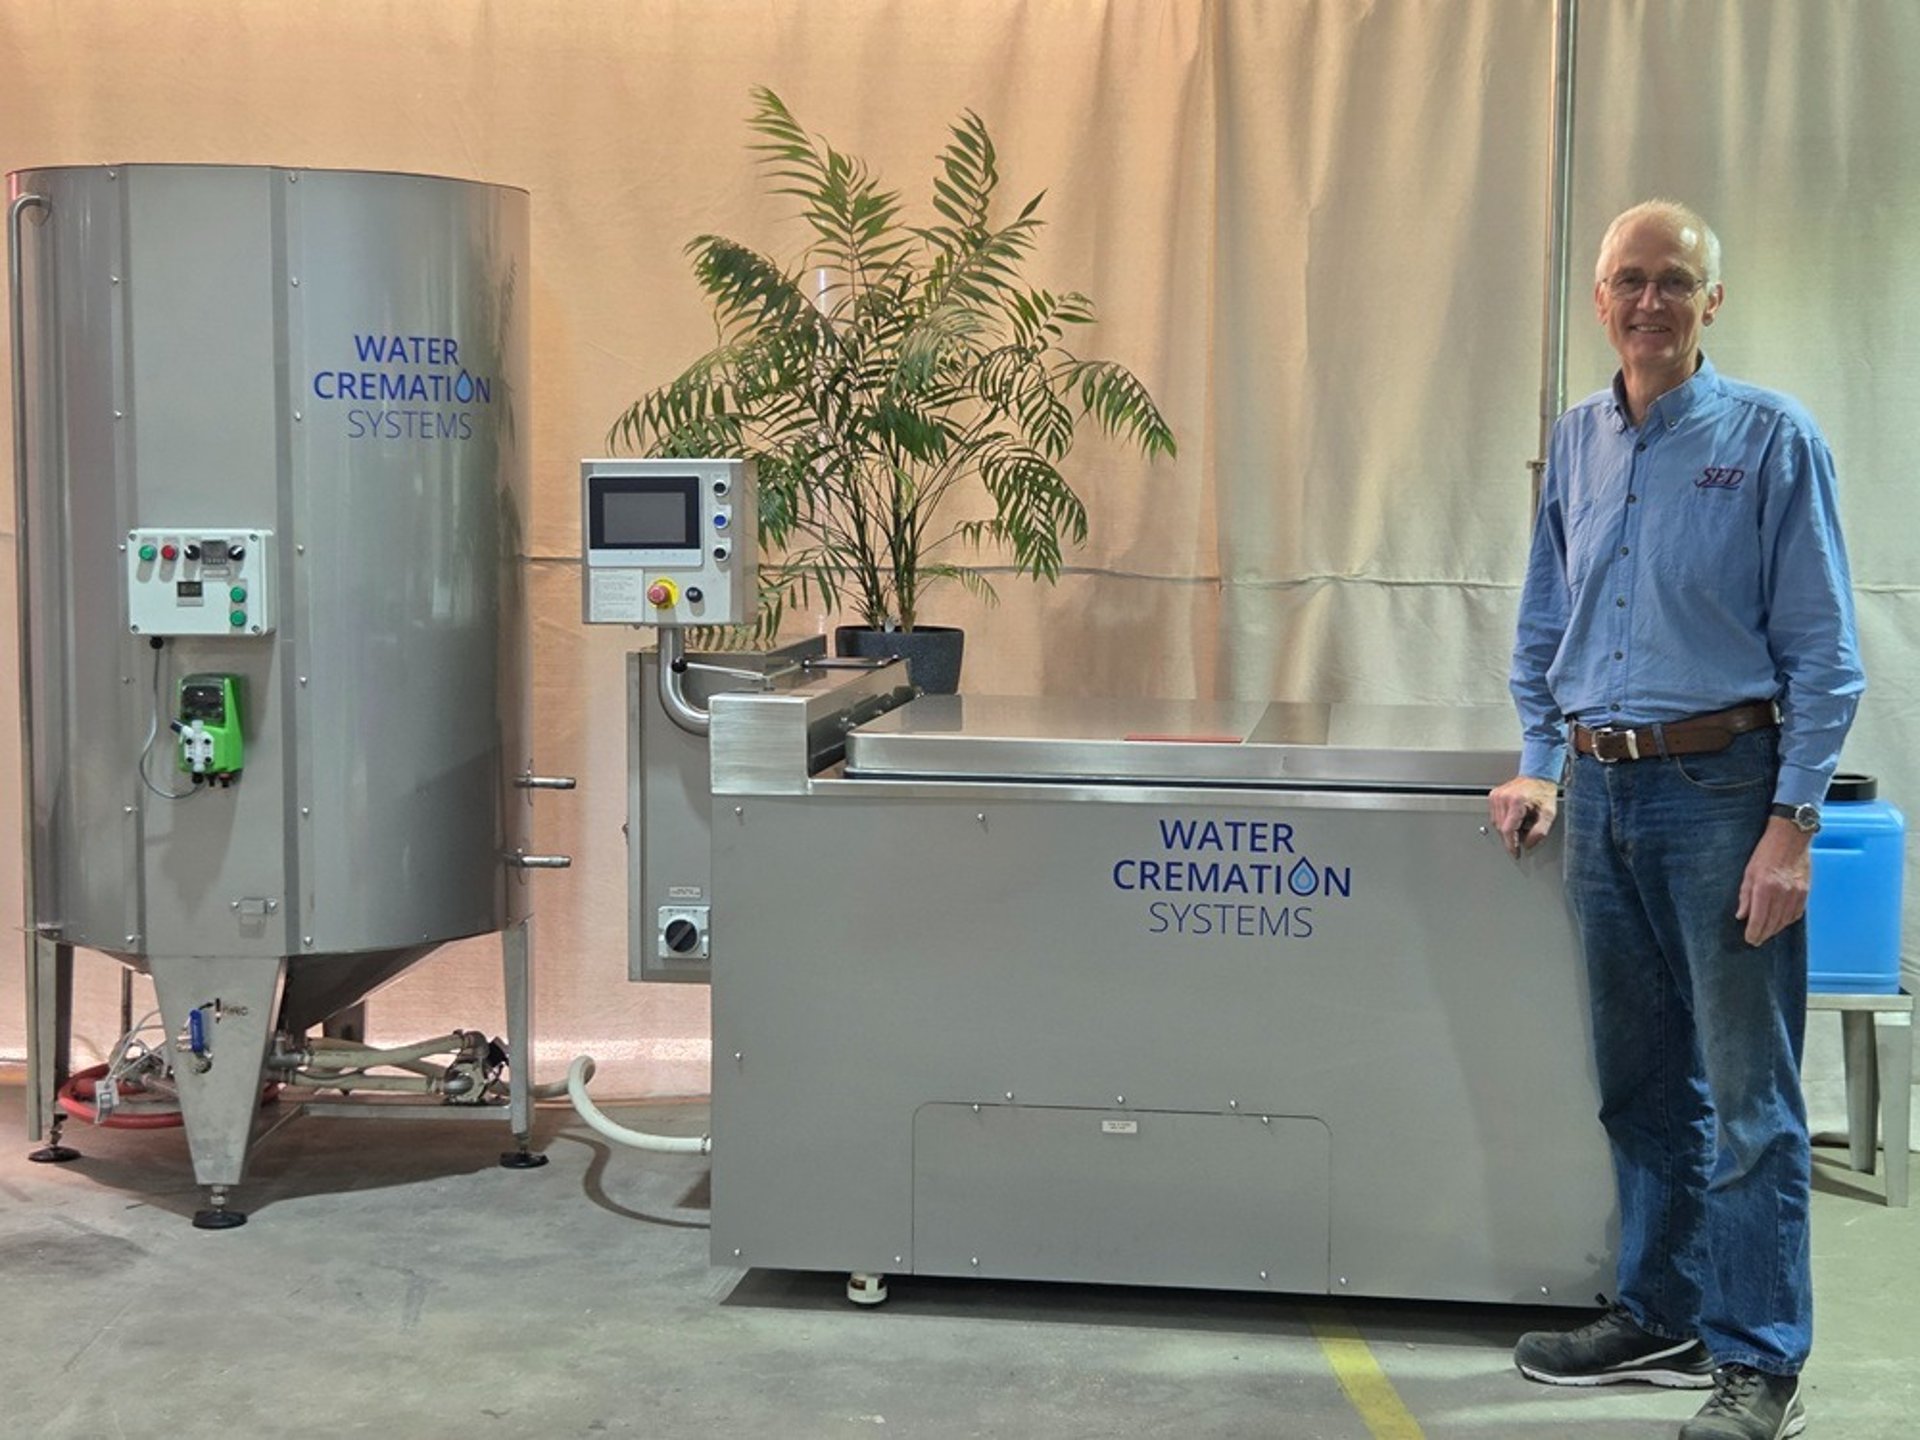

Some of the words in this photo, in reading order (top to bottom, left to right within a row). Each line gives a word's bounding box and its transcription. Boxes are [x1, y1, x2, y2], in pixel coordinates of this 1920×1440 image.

[354, 335, 459, 366] WATER
[313, 369, 491, 403] CREMATION
[348, 410, 472, 440] SYSTEMS
[1159, 819, 1295, 853] WATER
[1113, 856, 1351, 897] CREMATION
[1150, 901, 1313, 938] SYSTEMS
